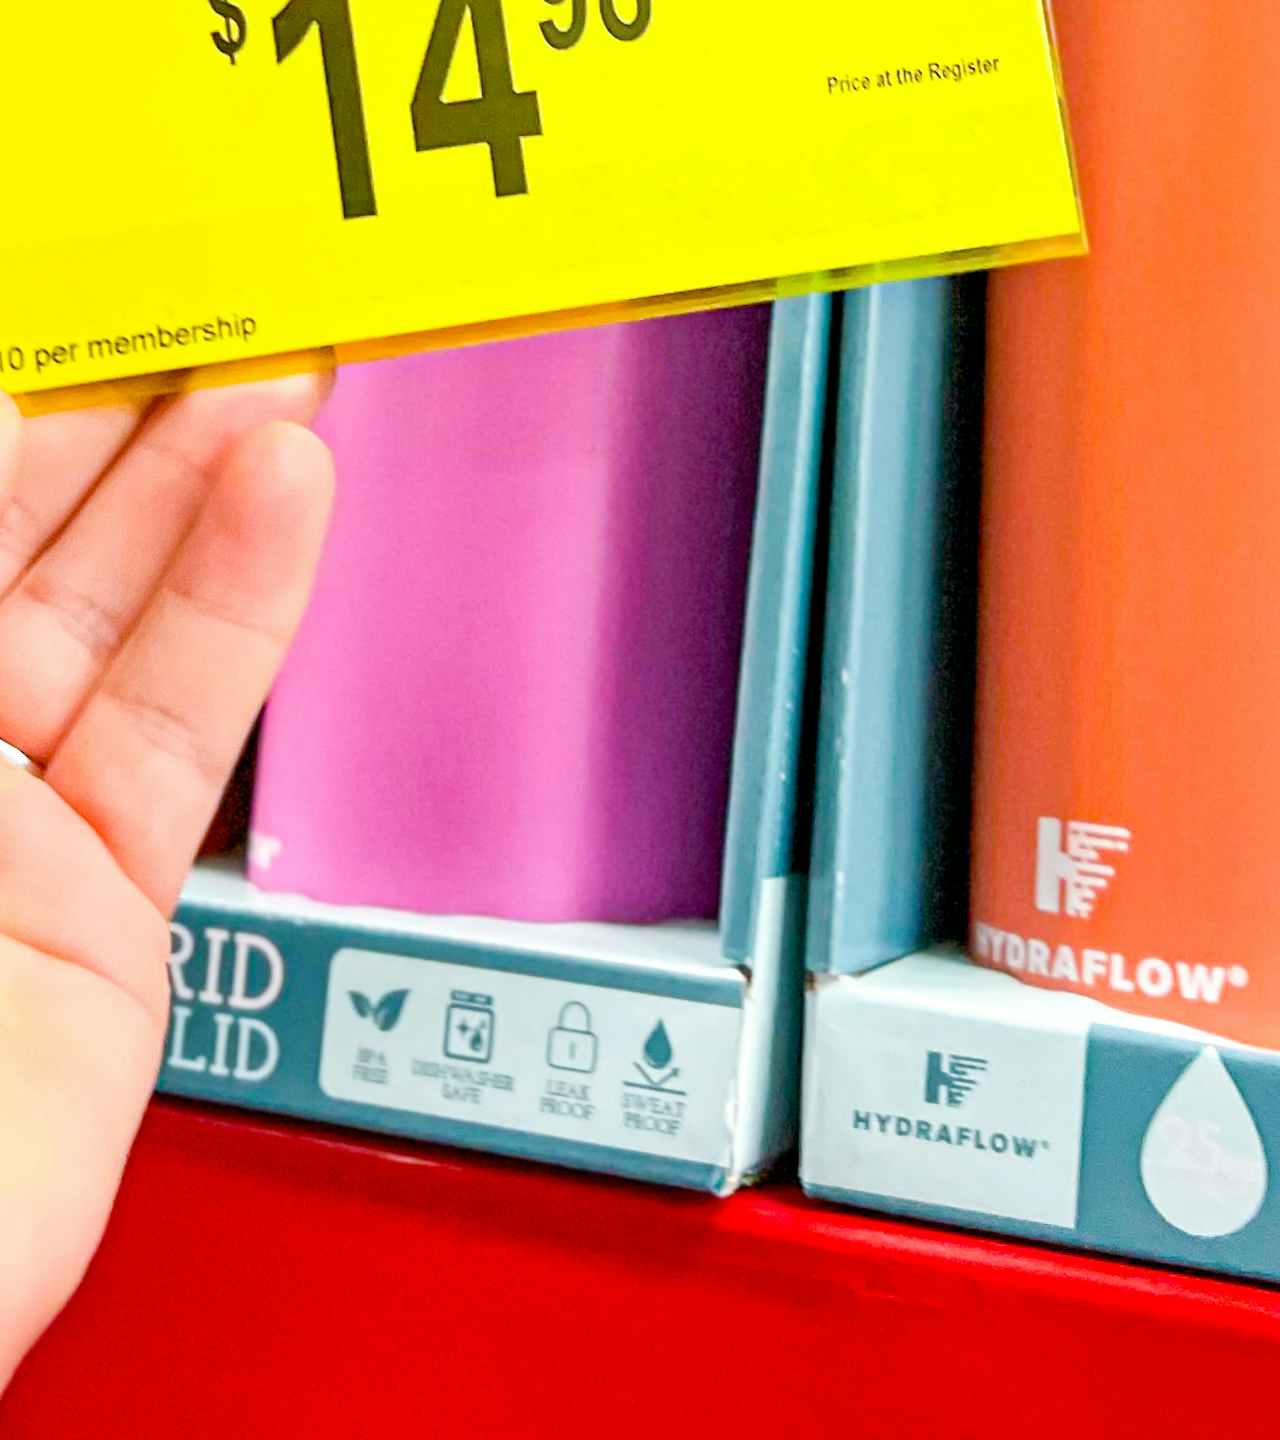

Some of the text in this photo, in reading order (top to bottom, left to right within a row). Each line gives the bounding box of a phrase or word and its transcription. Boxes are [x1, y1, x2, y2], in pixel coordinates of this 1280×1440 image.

[827, 57, 1000, 96] Price at the Register
[34, 343, 81, 374] per
[87, 313, 258, 361] membership
[167, 922, 285, 1012] RID
